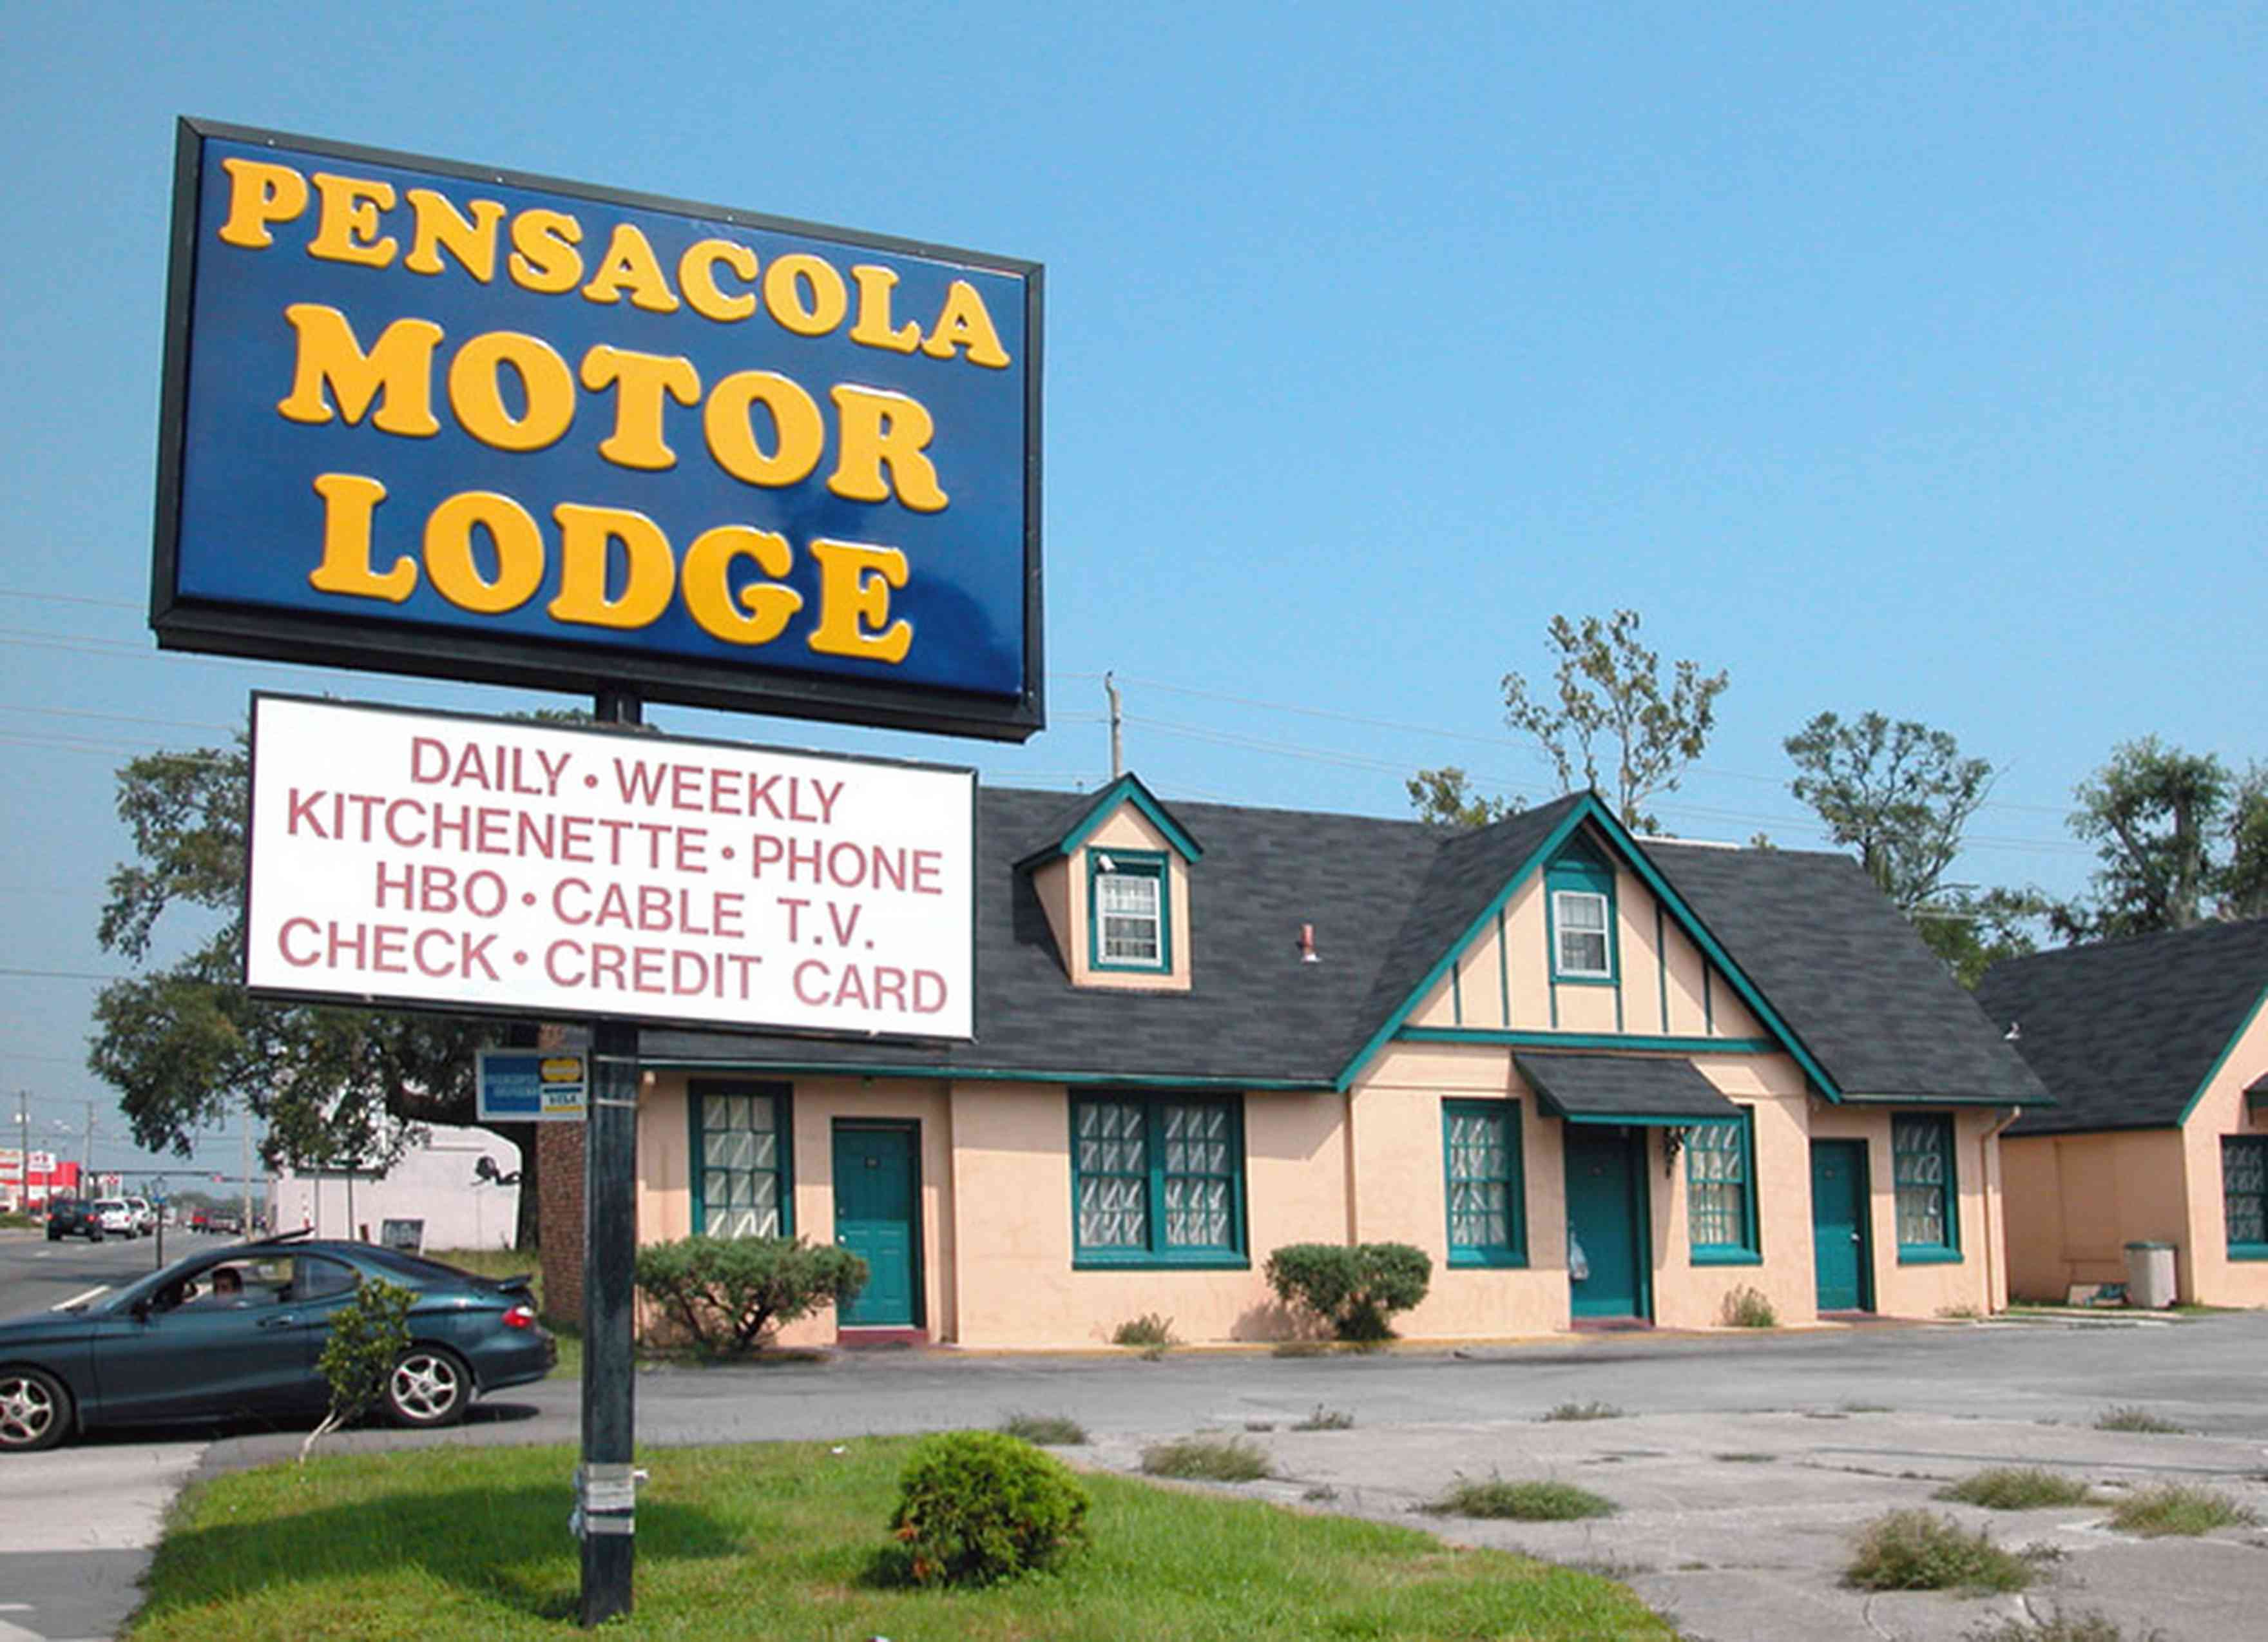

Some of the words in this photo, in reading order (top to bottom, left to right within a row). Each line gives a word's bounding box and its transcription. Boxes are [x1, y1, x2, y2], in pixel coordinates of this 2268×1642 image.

[218, 158, 1009, 368] PENSACOLA
[277, 304, 948, 512] MOTOR
[309, 474, 912, 664] LODGE
[411, 736, 573, 797] DAILY
[613, 757, 845, 826] WEEKLY
[287, 787, 709, 875] KITCHENETTE
[751, 833, 944, 896] PHONE
[376, 860, 508, 918] HBO
[552, 876, 744, 939] CABLE
[776, 896, 875, 949] T.V.
[277, 916, 499, 981] CHECK
[544, 938, 763, 1001] CREDIT
[793, 958, 948, 1014] CARD
